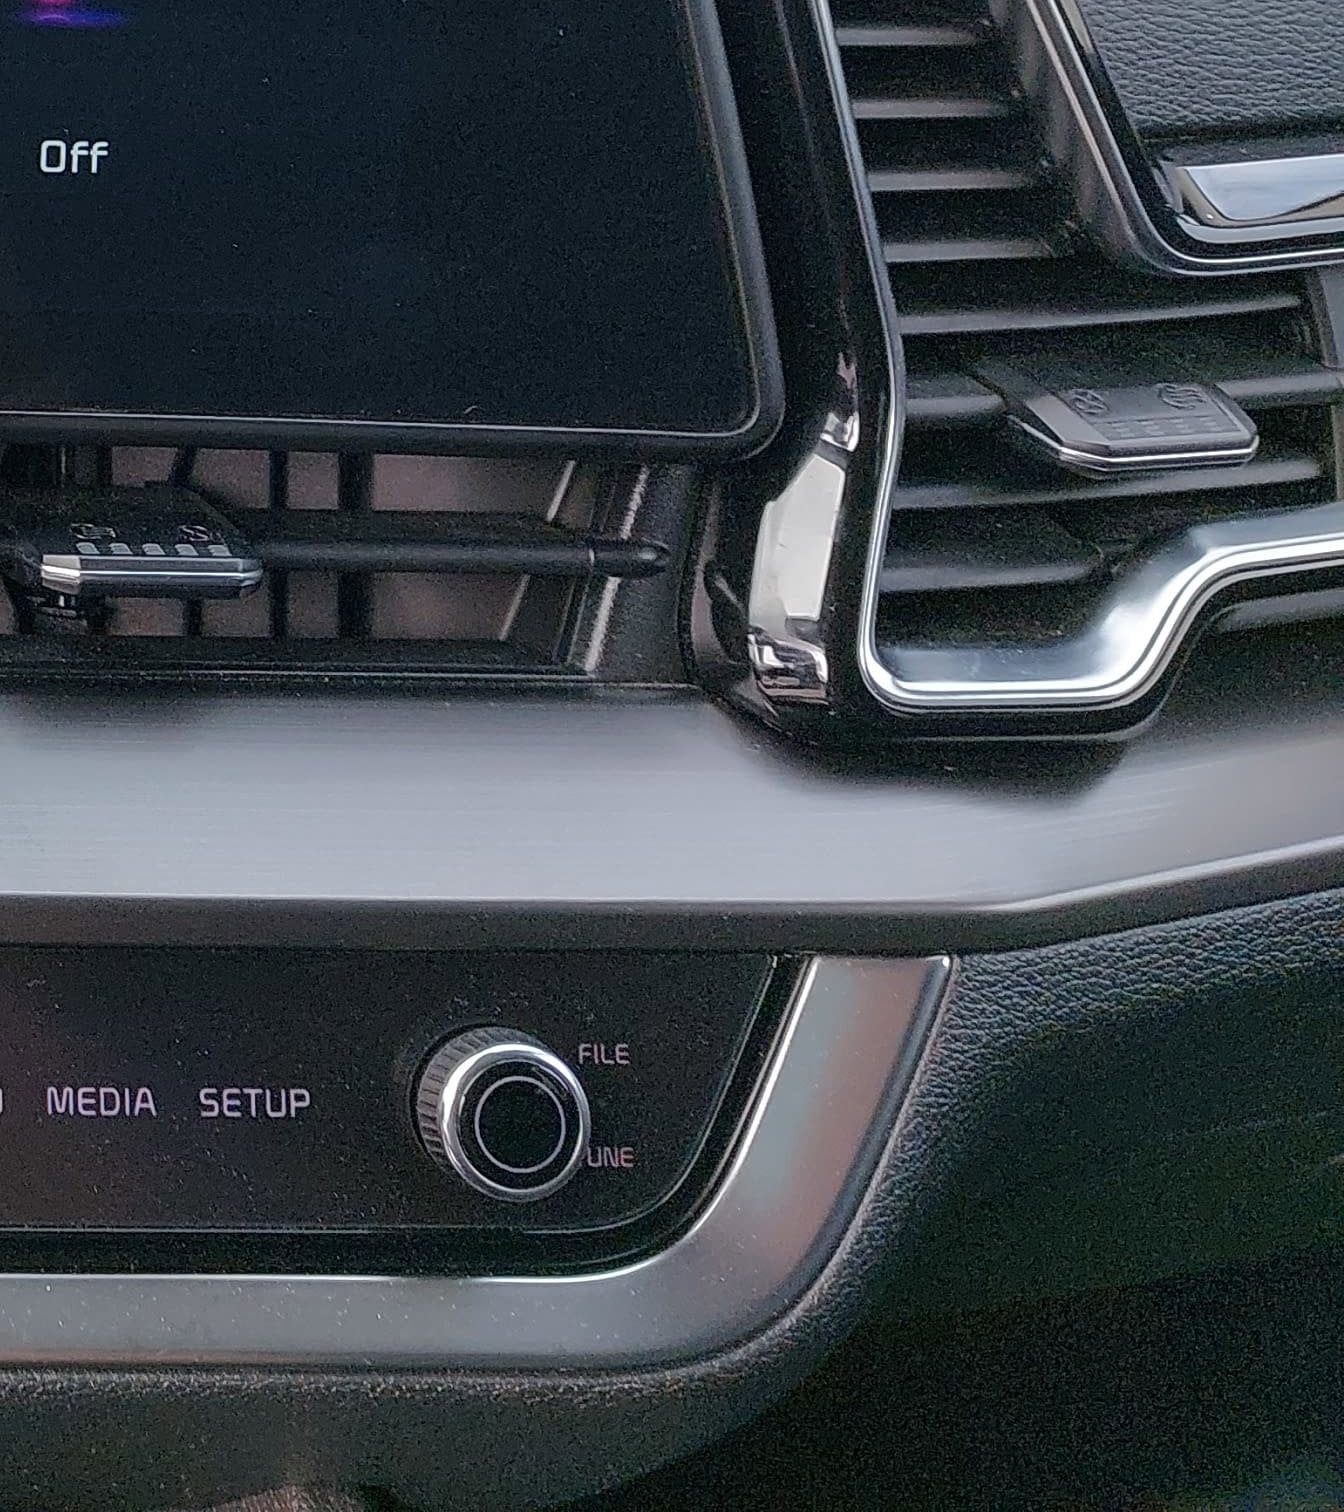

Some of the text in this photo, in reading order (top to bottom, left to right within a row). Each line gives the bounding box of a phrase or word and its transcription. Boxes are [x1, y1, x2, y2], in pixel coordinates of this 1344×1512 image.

[39, 139, 110, 174] Off
[578, 1043, 631, 1065] FILE
[46, 1085, 157, 1118] MEDIA
[199, 1086, 311, 1120] SETUP
[580, 1146, 634, 1168] UNE
